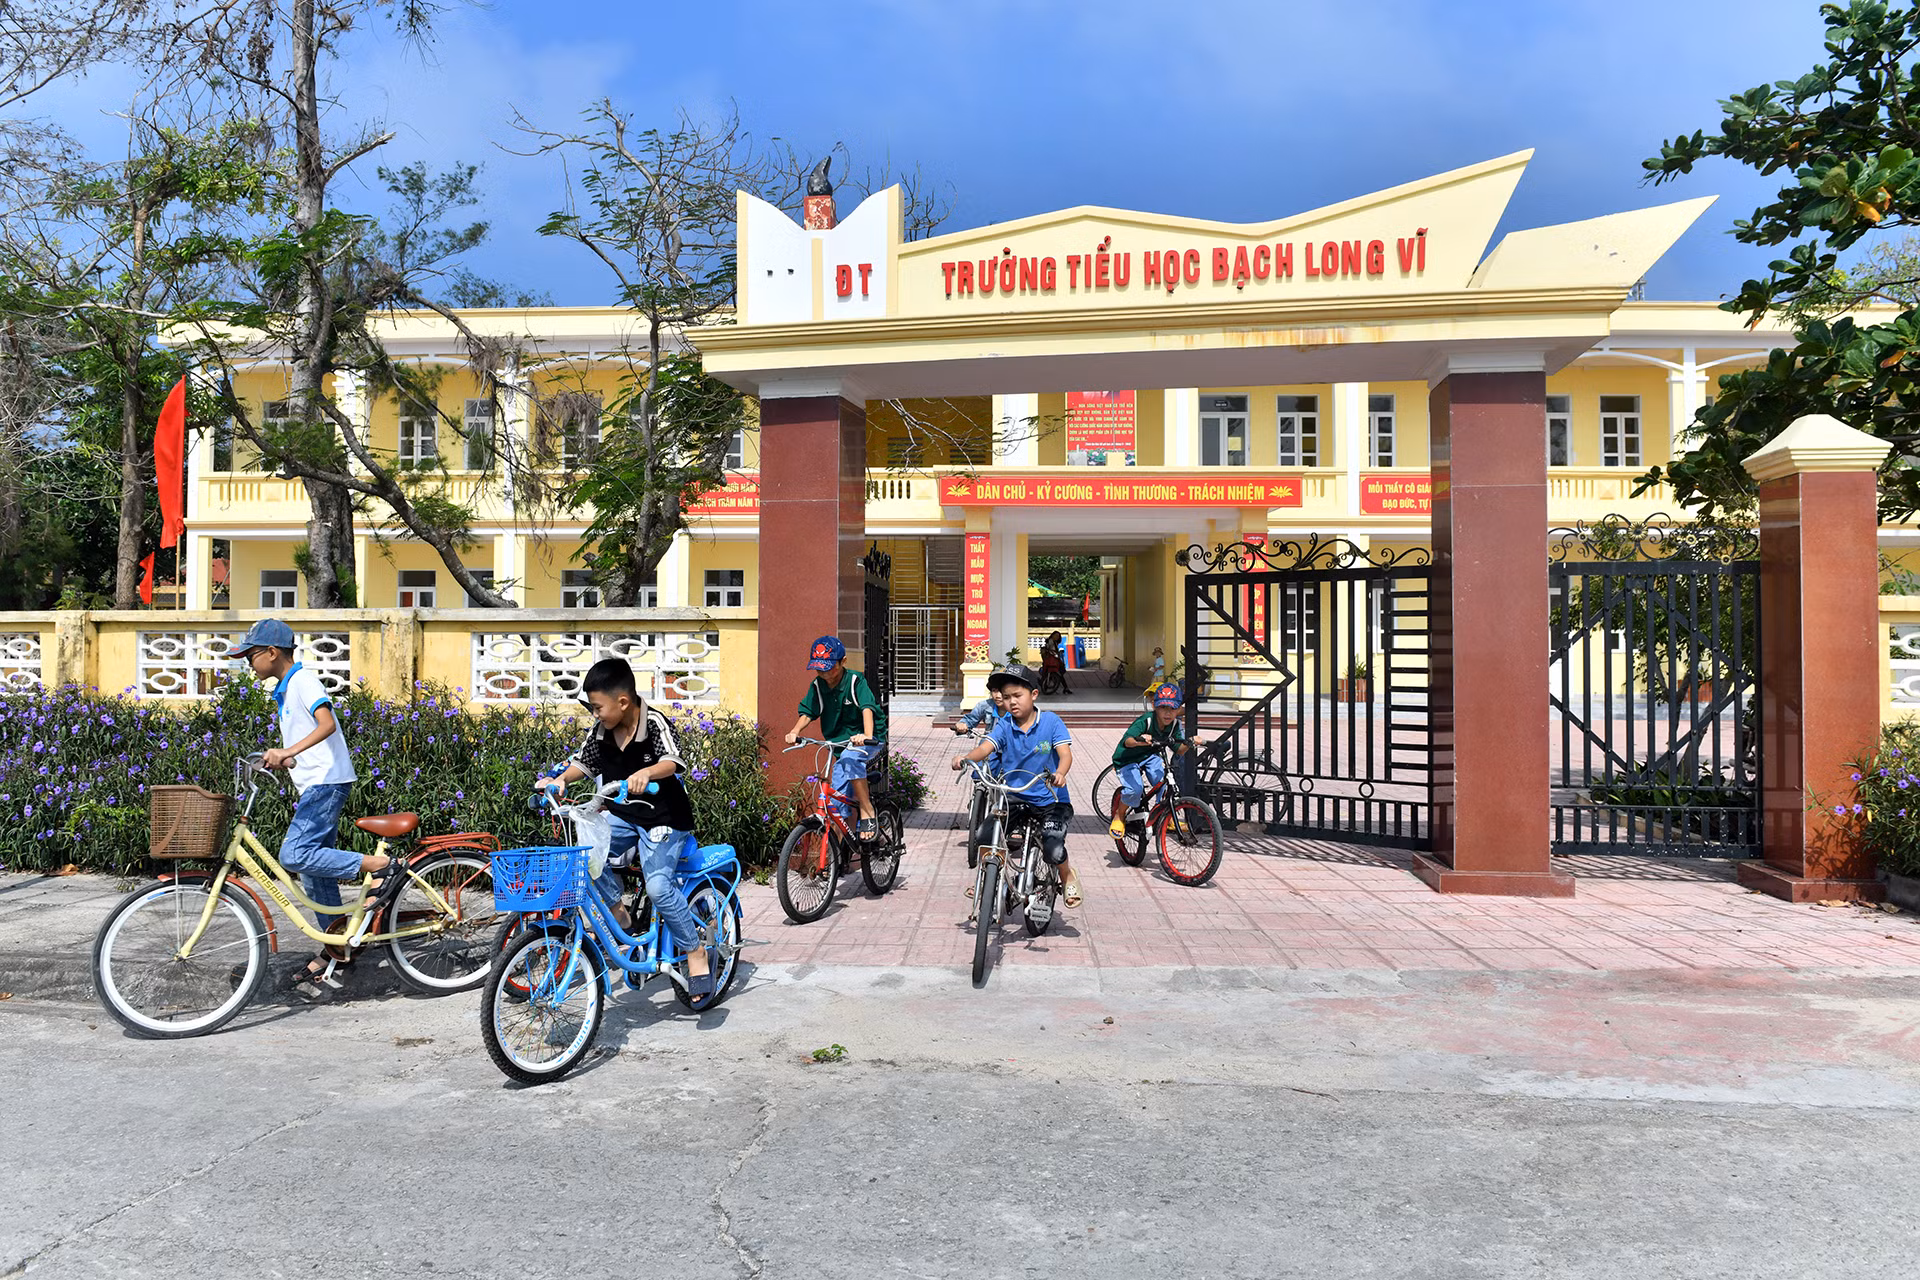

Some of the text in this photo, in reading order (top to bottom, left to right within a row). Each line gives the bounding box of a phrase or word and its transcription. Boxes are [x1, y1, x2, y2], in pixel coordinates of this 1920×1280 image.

[941, 227, 1429, 295] TRƯỜNG TIỂU HỌC BẠCH LONG VĨ
[977, 481, 1000, 500] DÂN
[1003, 480, 1026, 500] CHỦ
[1037, 480, 1052, 500] KỶ
[1054, 484, 1093, 500] CƯƠNG
[1104, 482, 1130, 500] TÌNH
[1133, 484, 1177, 500] THƯƠNG
[1188, 482, 1225, 500] TRÁCH
[1227, 482, 1265, 503] NHIỆM
[1405, 482, 1415, 494] CÔ
[718, 496, 737, 508] TRĂM
[737, 496, 754, 508] NĂM
[1382, 498, 1398, 511] ĐẠO
[966, 619, 988, 630] NGOAN
